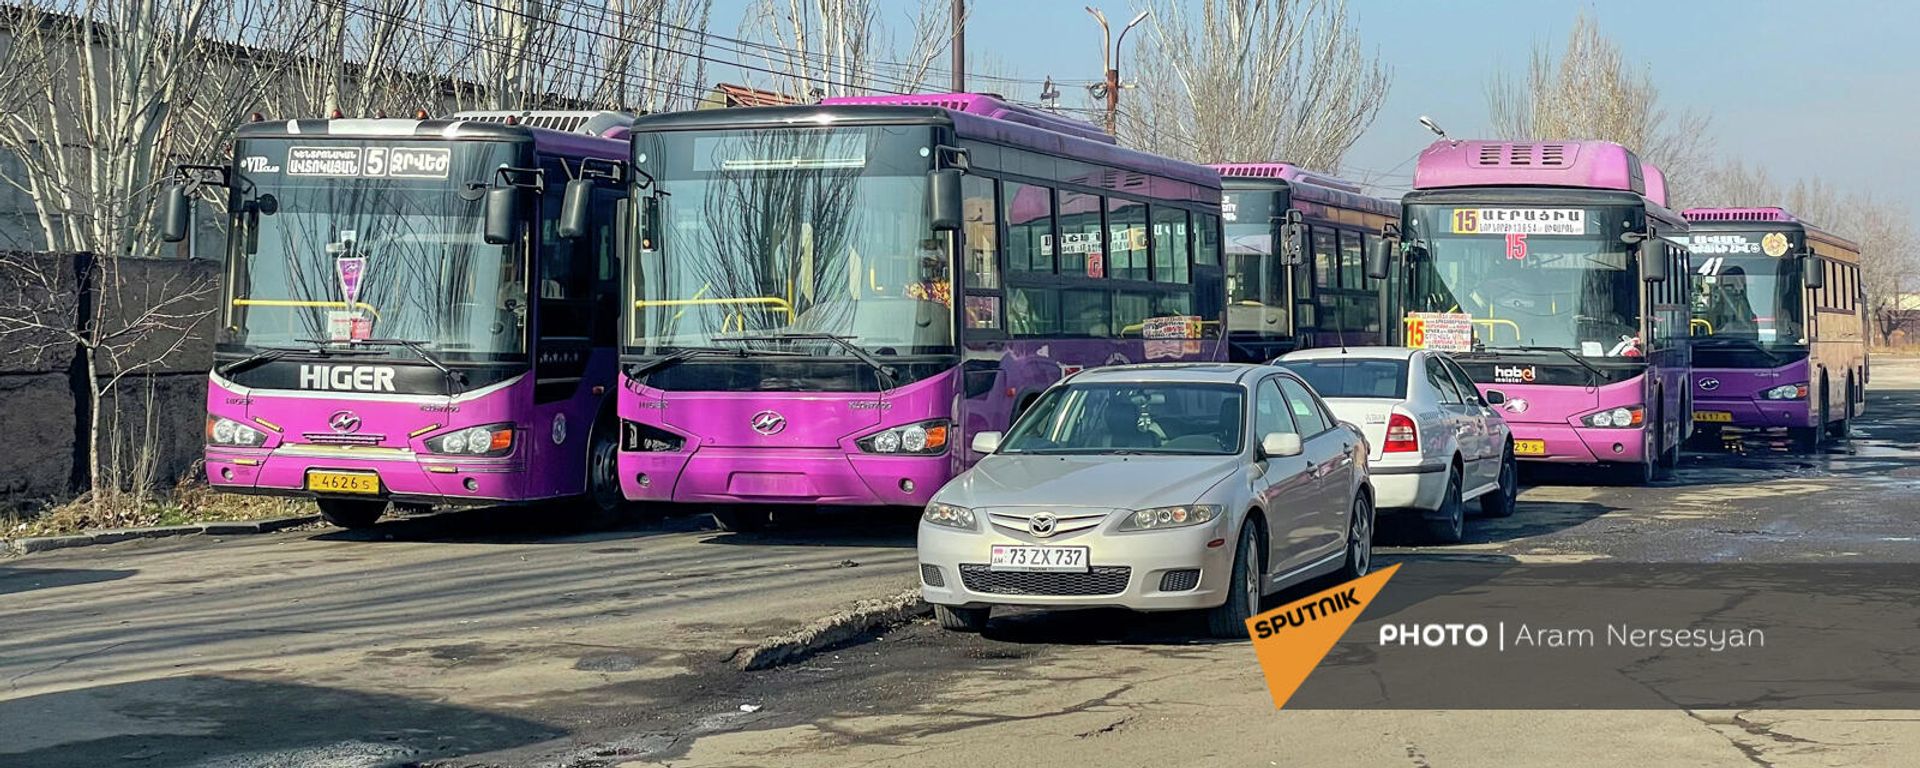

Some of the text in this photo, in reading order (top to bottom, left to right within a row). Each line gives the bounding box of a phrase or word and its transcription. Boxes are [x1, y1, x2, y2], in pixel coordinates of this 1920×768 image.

[290, 159, 357, 174] ԱՎՏՈԿԱՅԱՆ
[367, 150, 383, 174] 5
[392, 152, 448, 172] ՋՐՎԵԺ
[1455, 210, 1477, 232] 15
[1505, 233, 1527, 259] 15
[1697, 257, 1723, 275] 41
[1408, 320, 1425, 347] 15
[300, 364, 396, 392] HIGER
[1495, 365, 1536, 381] habel
[1514, 442, 1528, 452] 29
[321, 475, 358, 489] 4626
[1010, 548, 1082, 566] 73 ZX 737
